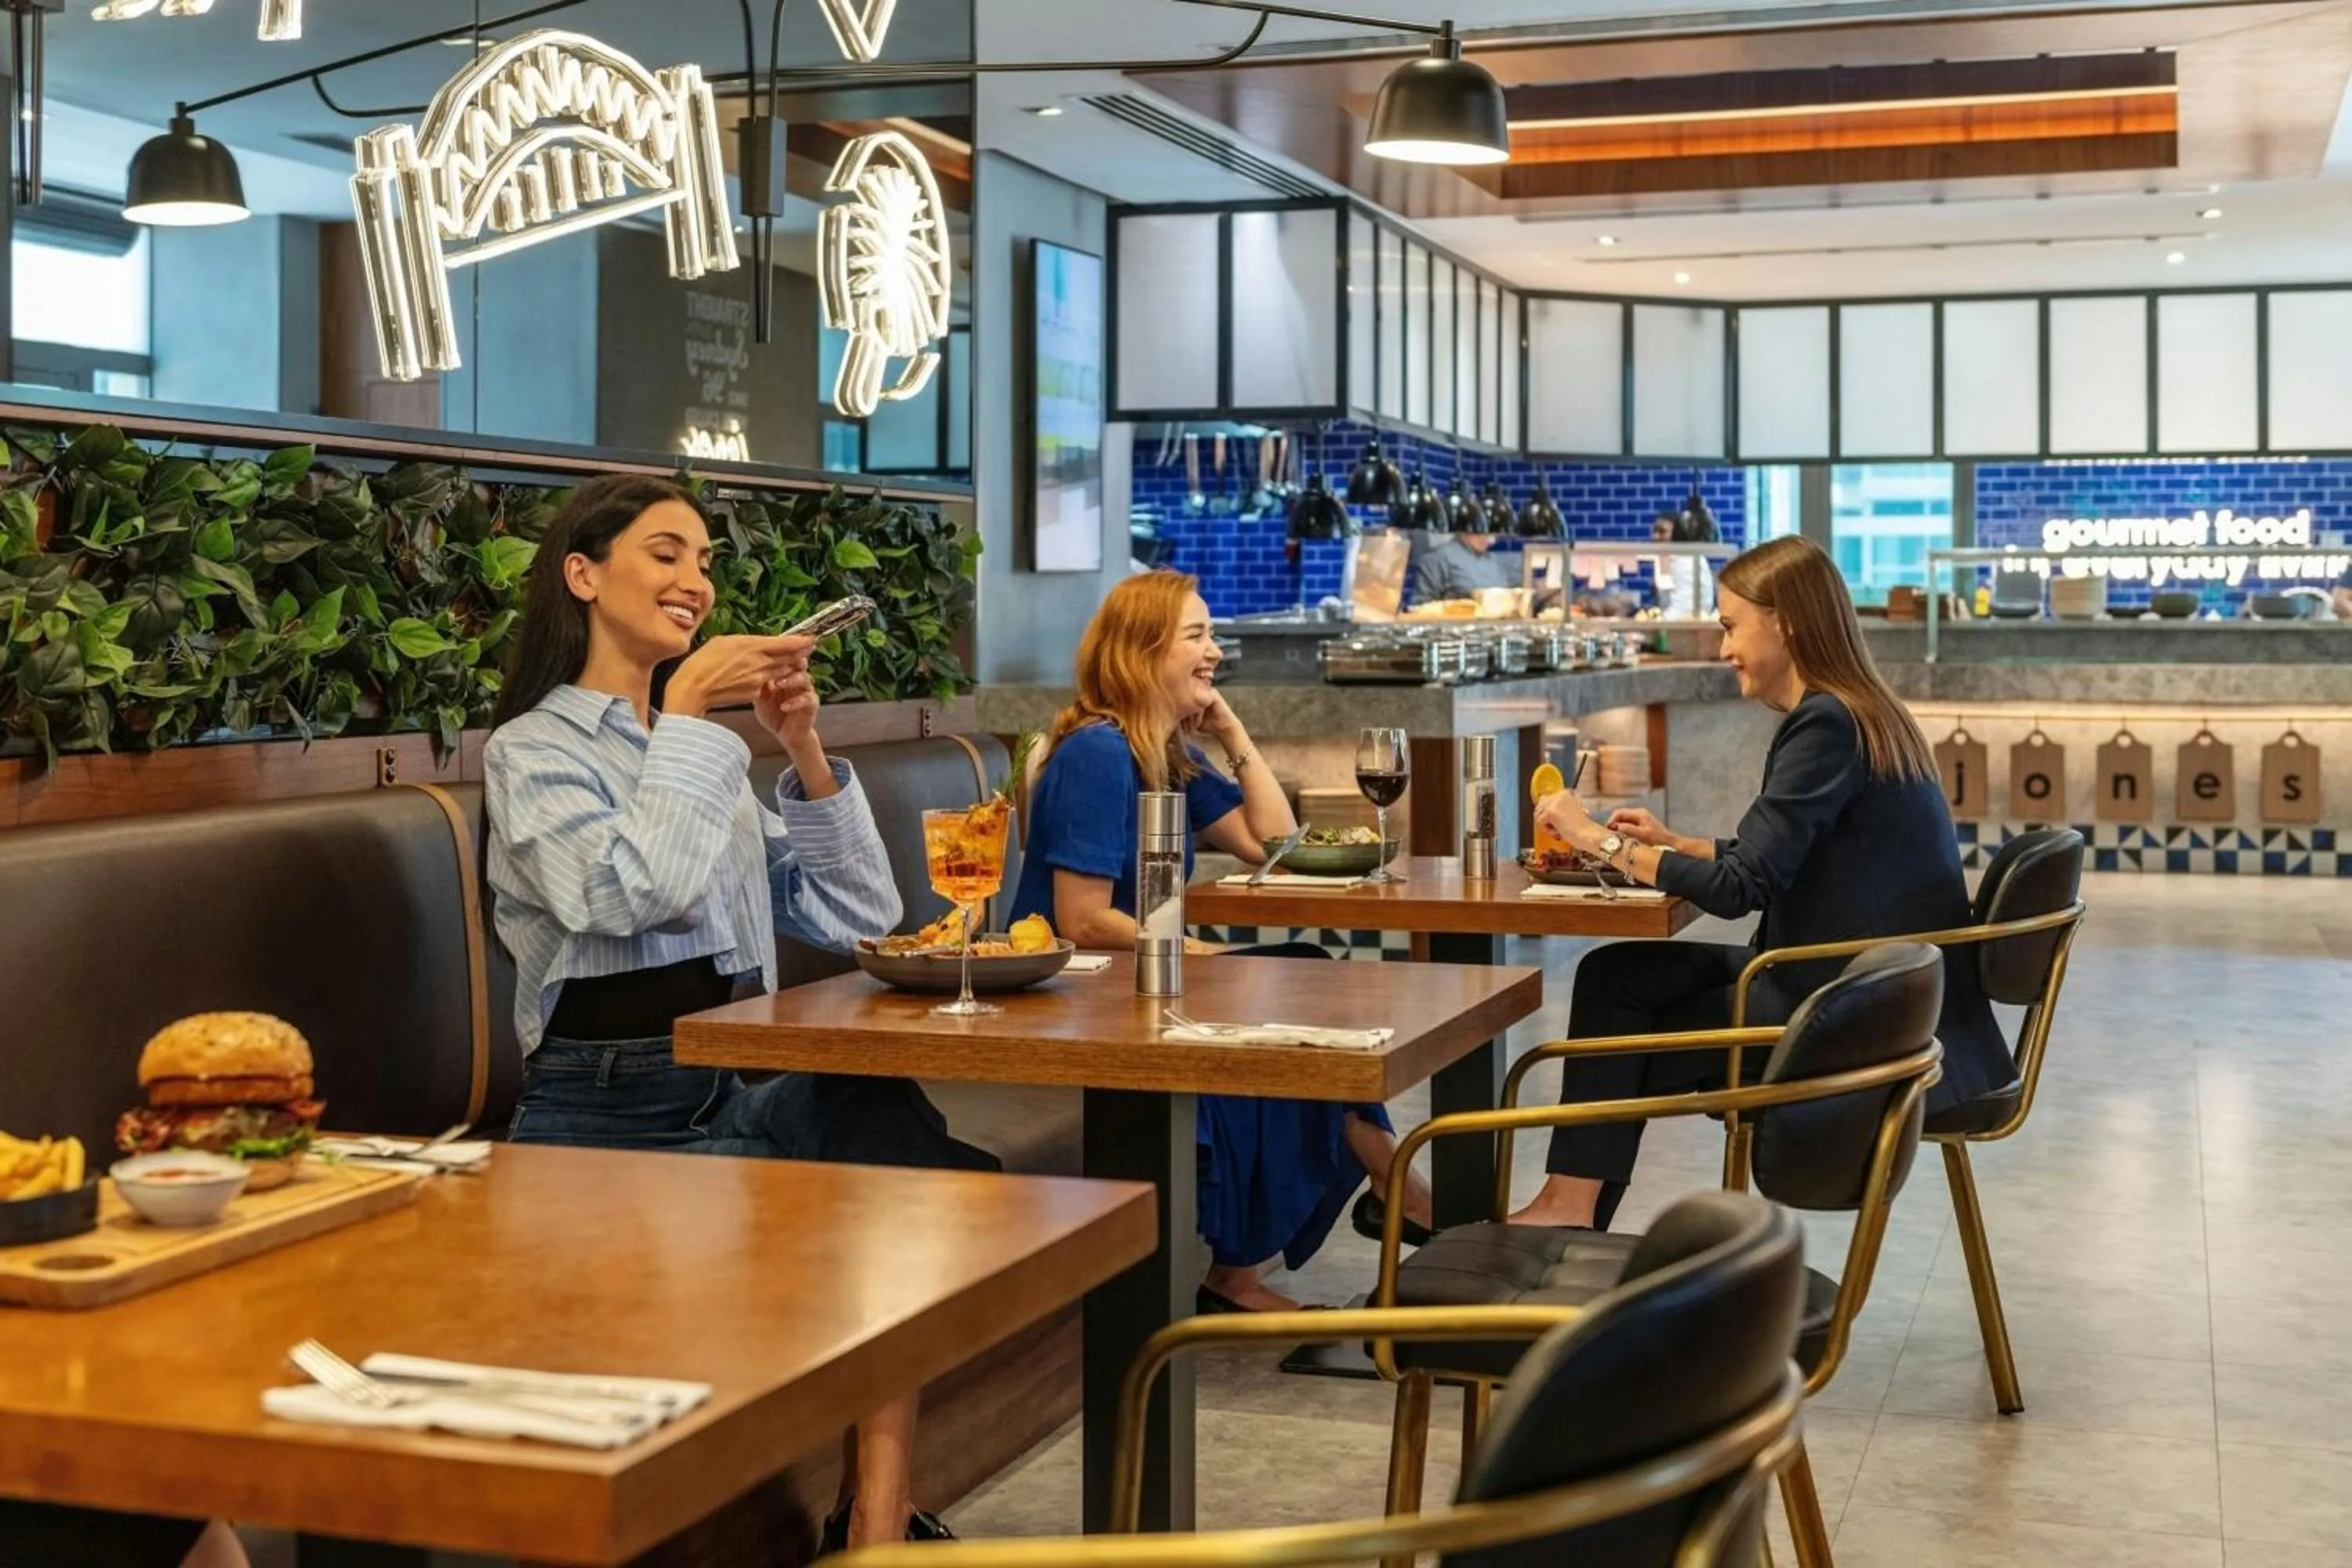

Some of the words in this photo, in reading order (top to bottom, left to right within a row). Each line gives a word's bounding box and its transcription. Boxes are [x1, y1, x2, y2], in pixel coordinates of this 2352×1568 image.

[2042, 511, 2210, 552] gourmet
[2215, 509, 2310, 546] food
[1953, 762, 2302, 807] jones
